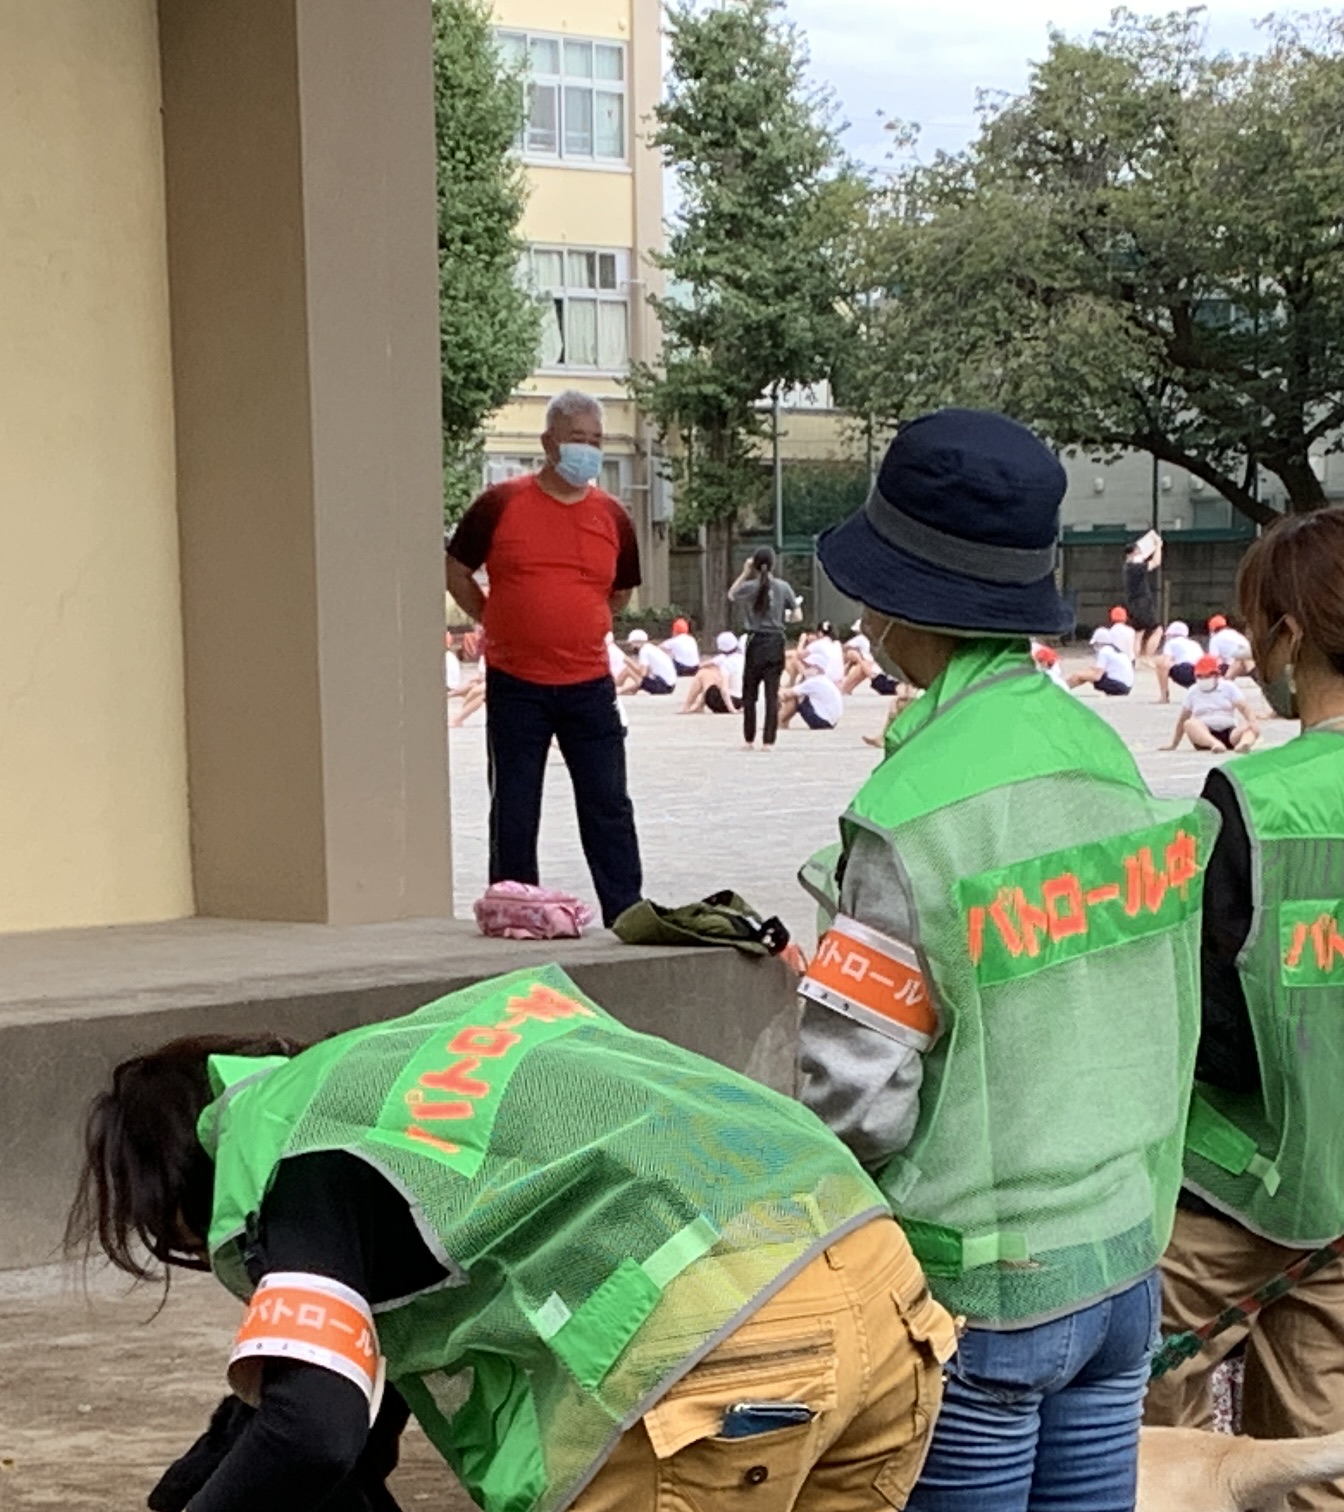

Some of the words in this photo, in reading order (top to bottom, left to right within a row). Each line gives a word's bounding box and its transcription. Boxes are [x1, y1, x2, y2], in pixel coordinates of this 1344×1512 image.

[967, 829, 1199, 966] パトロール中
